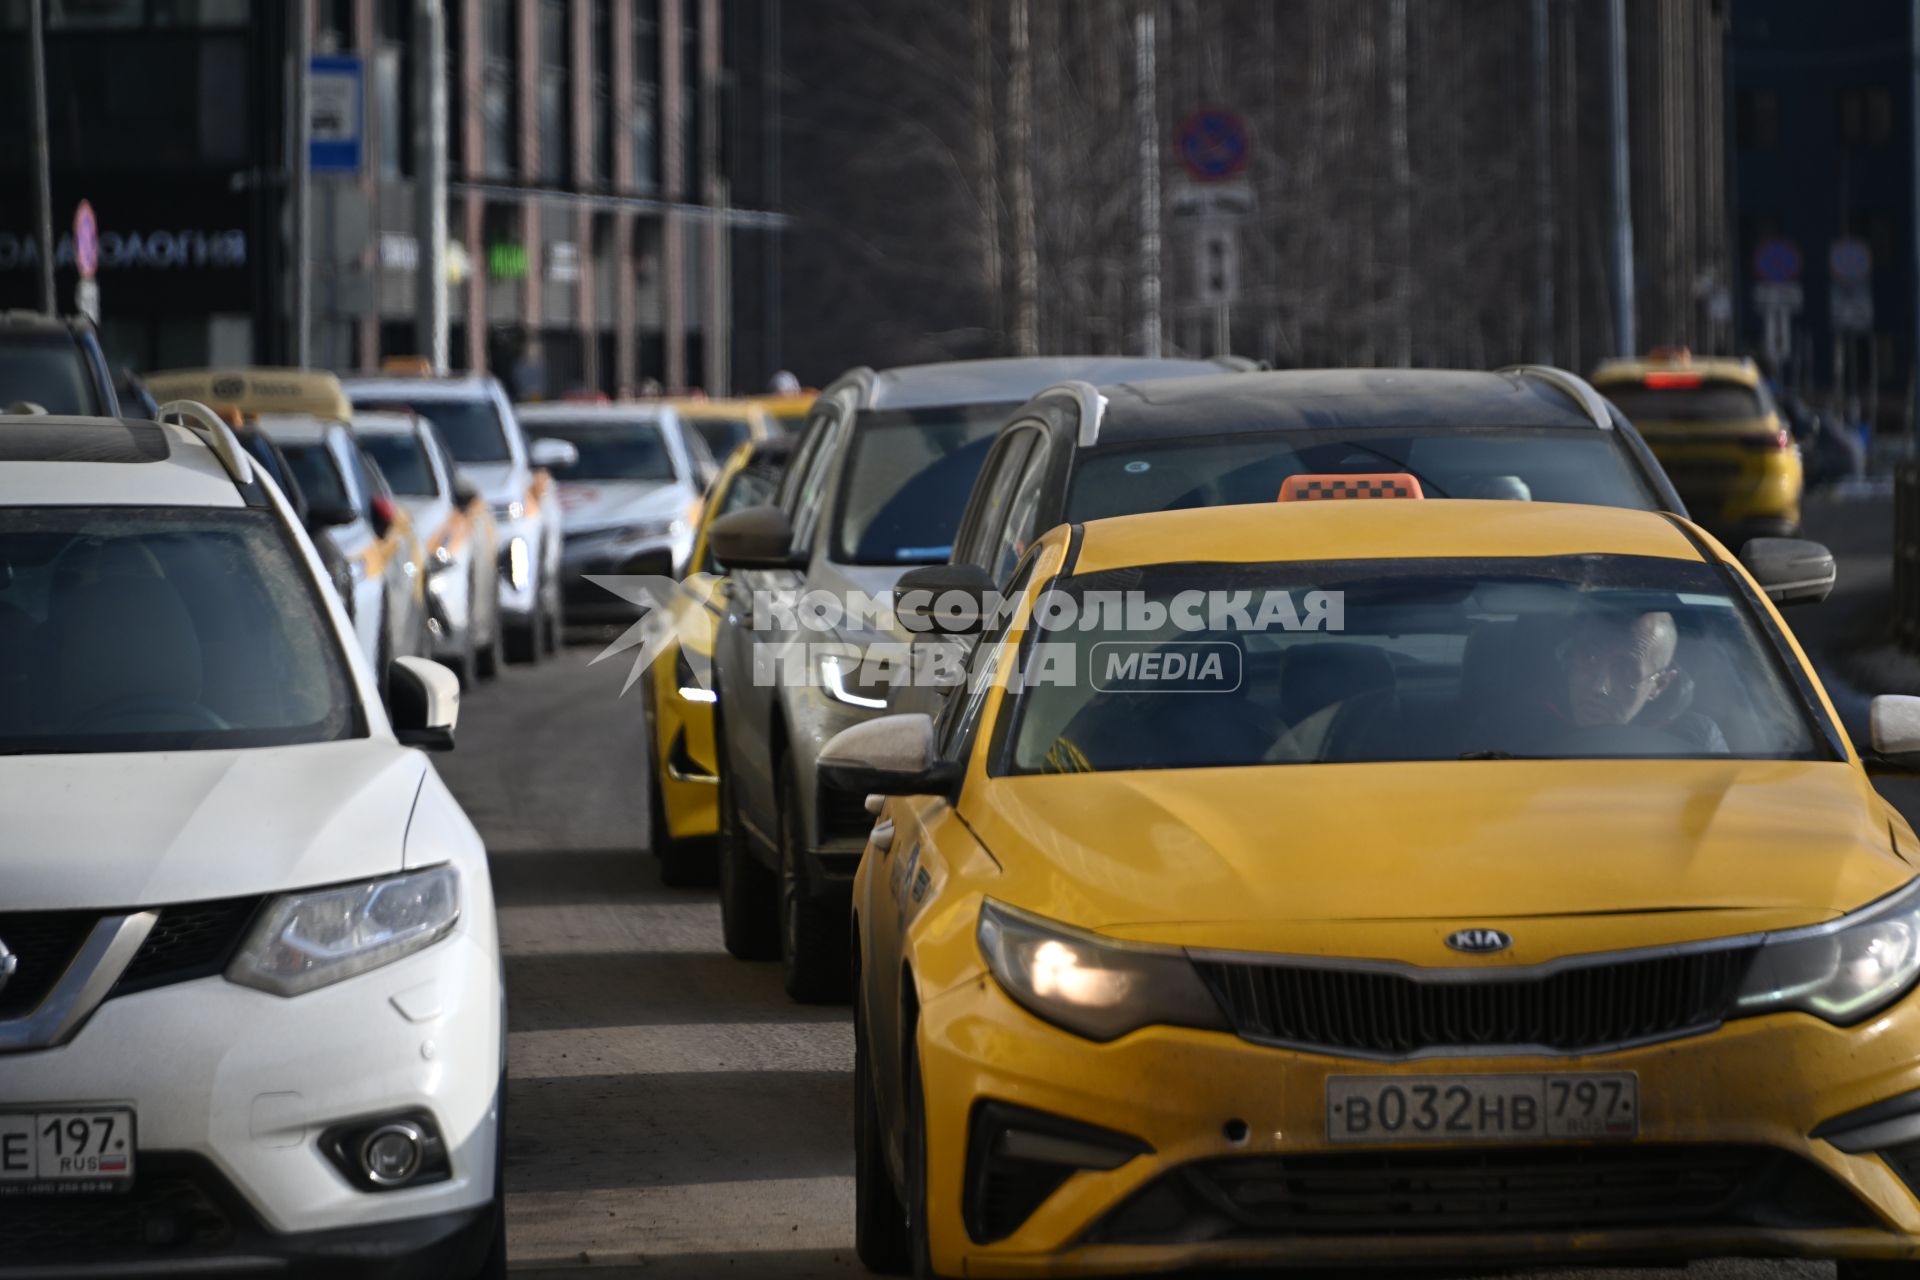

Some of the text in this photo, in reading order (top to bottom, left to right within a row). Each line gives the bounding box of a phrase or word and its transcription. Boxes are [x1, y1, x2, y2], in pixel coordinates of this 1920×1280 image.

[1455, 930, 1504, 948] KIA
[1345, 1080, 1622, 1132] В032НВ 797
[43, 1117, 115, 1156] 197
[60, 1156, 98, 1173] RUS
